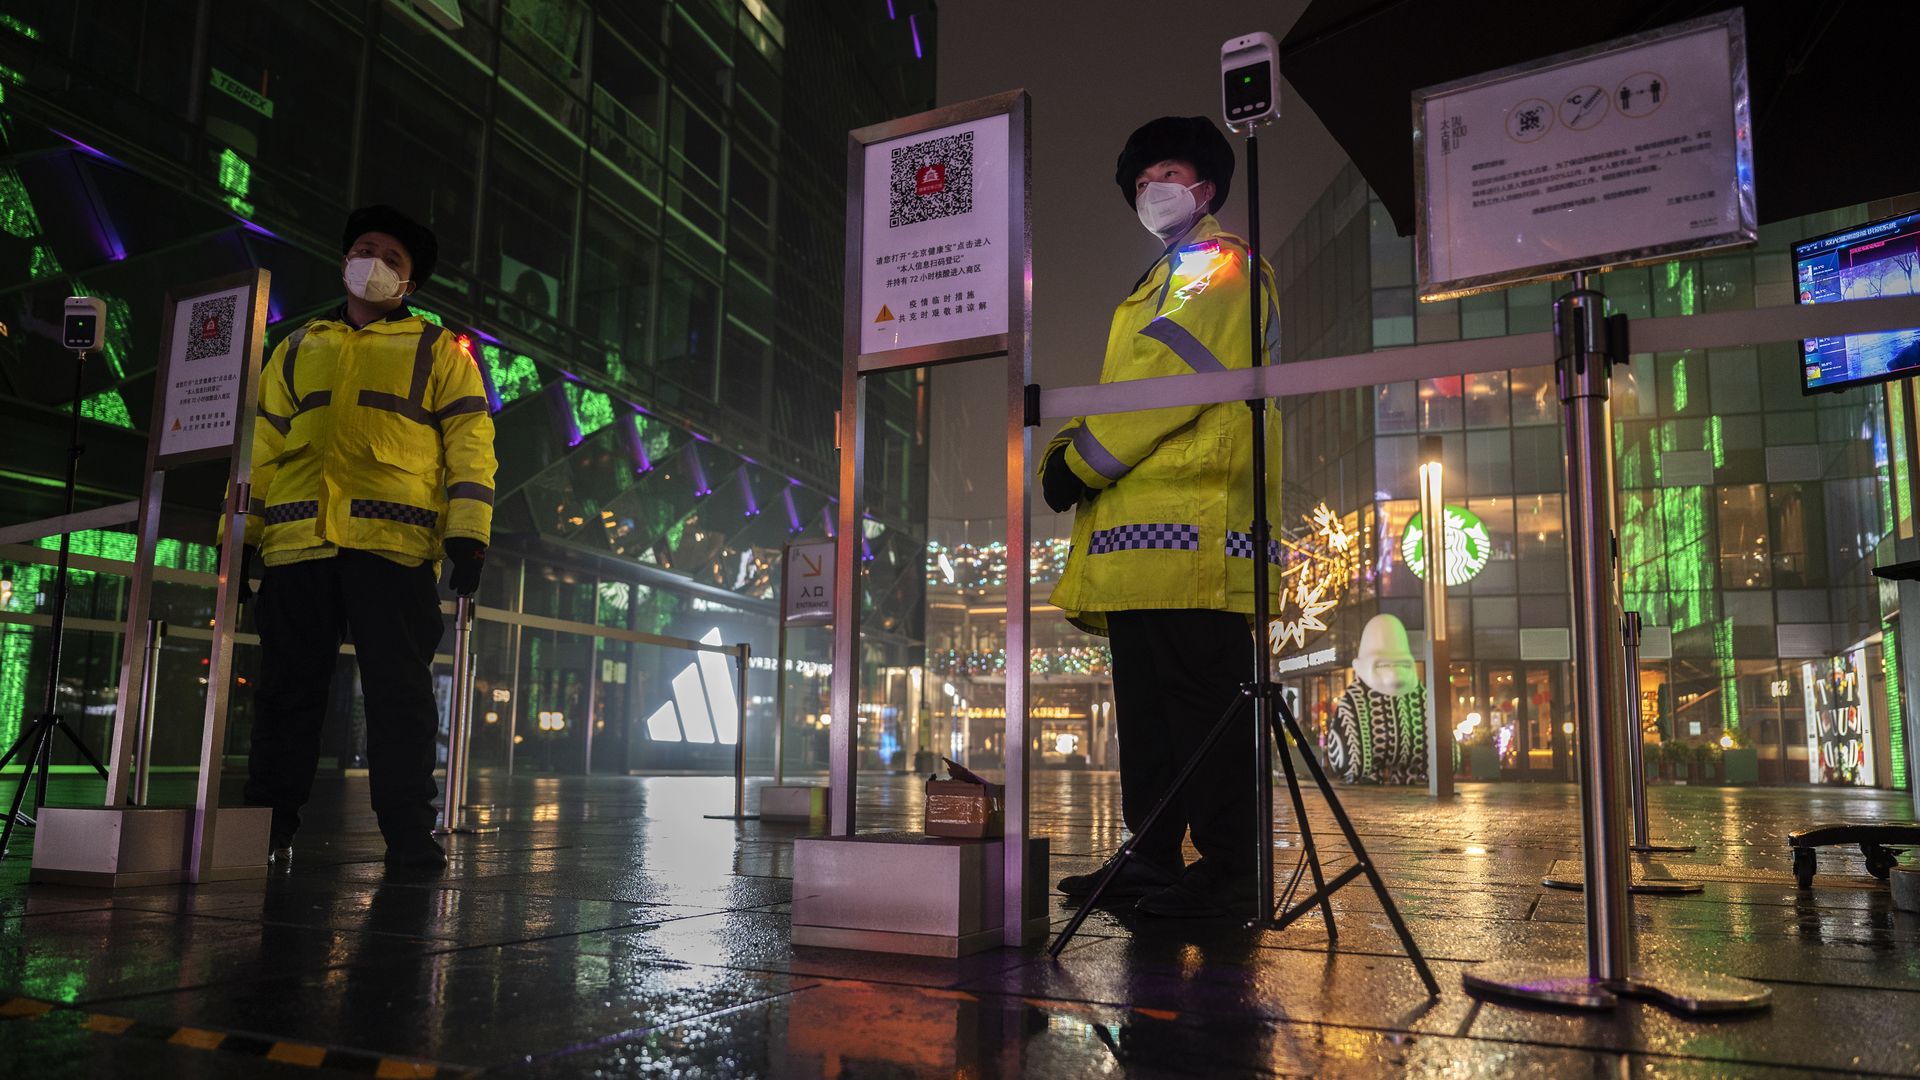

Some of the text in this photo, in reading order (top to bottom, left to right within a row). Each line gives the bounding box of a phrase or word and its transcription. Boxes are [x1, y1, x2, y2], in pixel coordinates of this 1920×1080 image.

[220, 76, 268, 110] TERREX
[910, 275, 919, 283] 72
[909, 290, 975, 309] 疫情临时措施
[801, 586, 824, 598] 入口
[796, 600, 829, 609] ENTRANCE
